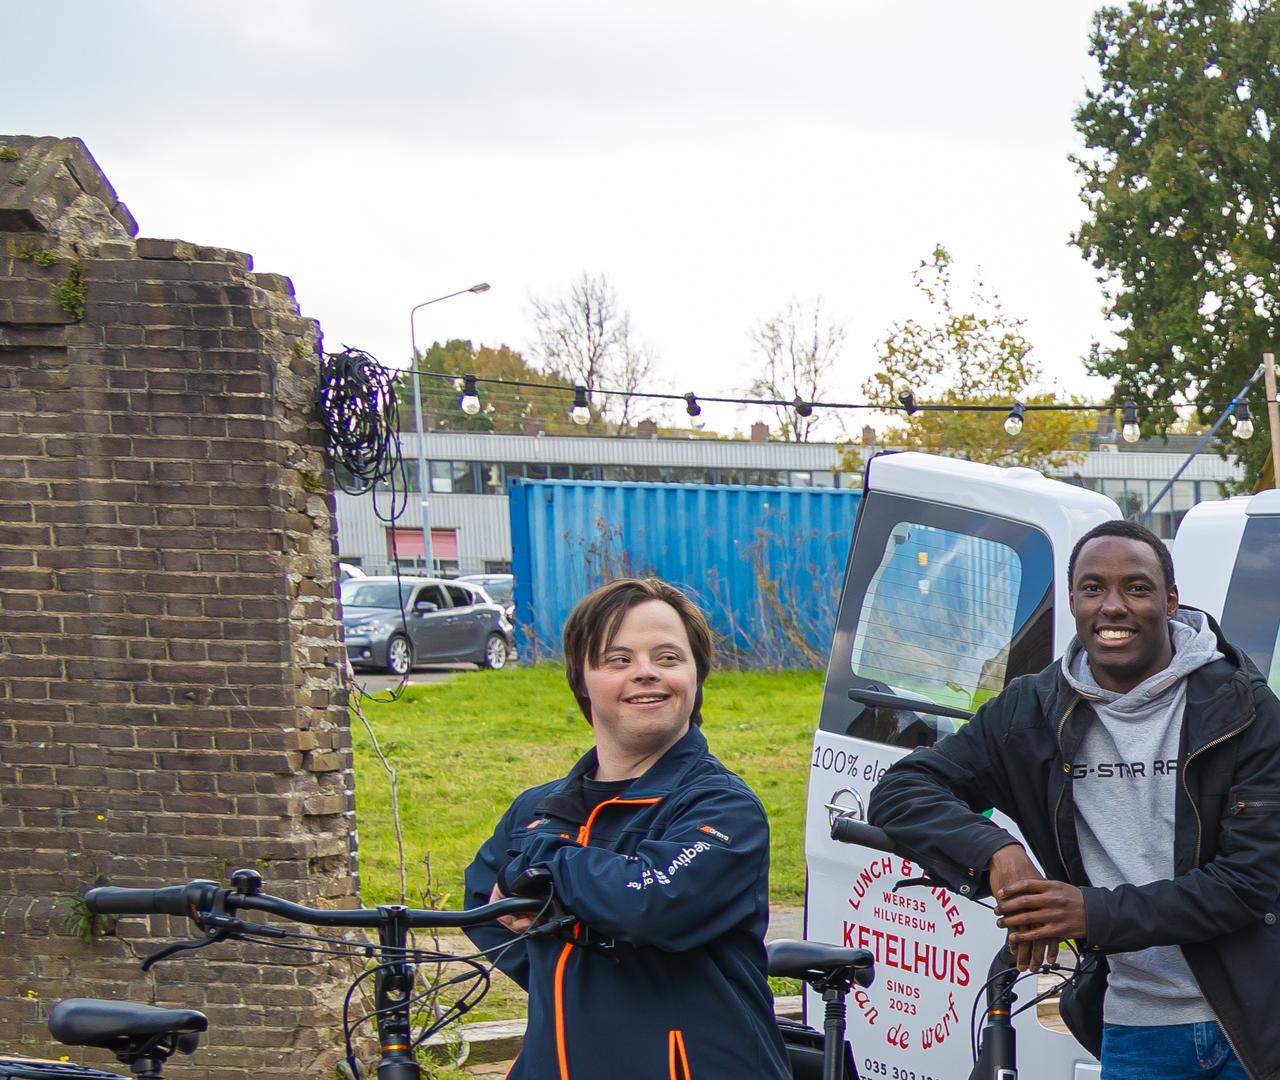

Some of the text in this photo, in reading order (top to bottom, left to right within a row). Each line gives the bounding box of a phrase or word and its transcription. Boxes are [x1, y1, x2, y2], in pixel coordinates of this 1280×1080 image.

[812, 746, 893, 782] 100% ele
[848, 857, 893, 911] LUNCH
[901, 857, 912, 877] &
[883, 891, 926, 913] WERF35
[873, 906, 936, 934] HILVERSUM
[886, 980, 920, 999] SINDS
[850, 982, 959, 1050] an de werf
[889, 998, 917, 1015] 2023
[864, 1058, 888, 1076] 035
